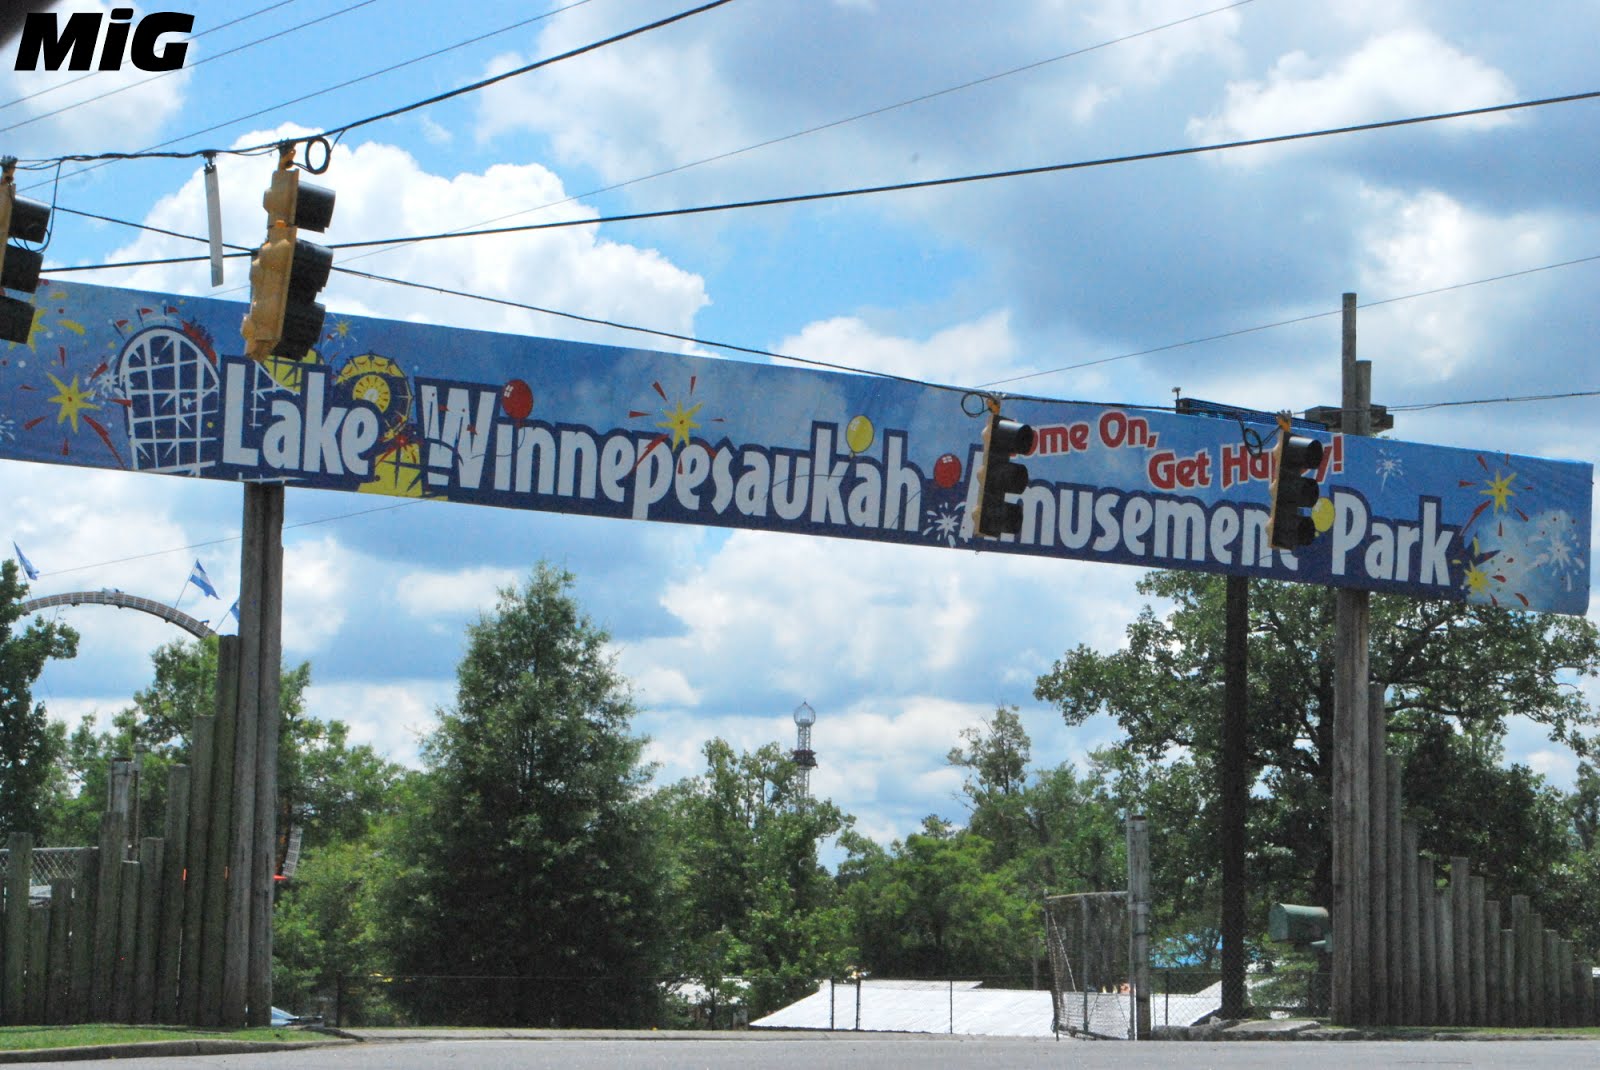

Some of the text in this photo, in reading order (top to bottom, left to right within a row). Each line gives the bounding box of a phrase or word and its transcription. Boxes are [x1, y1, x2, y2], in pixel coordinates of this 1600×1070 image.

[1099, 411, 1157, 448] On,
[221, 362, 1454, 586] Lake Winnepesaukah musemen Park
[1149, 435, 1343, 489] Get Hay!
